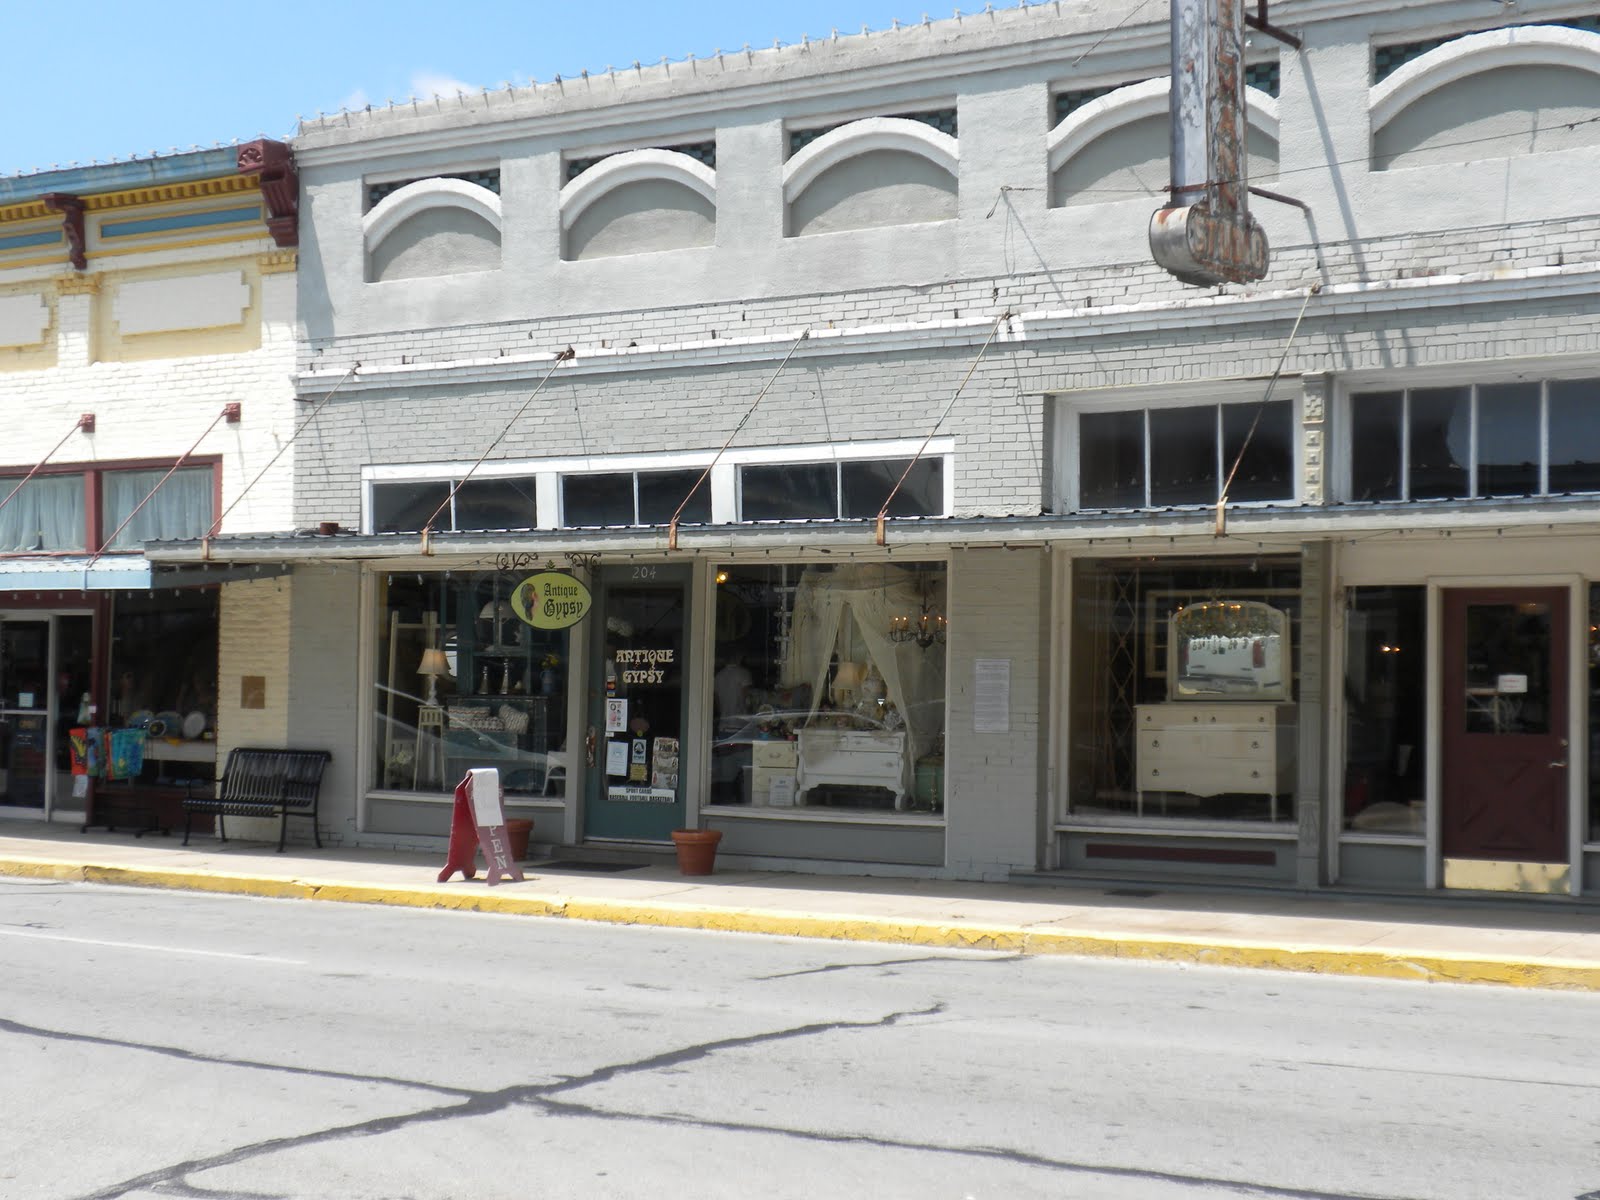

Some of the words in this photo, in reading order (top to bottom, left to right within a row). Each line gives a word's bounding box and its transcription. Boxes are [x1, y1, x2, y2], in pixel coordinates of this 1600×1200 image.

[632, 566, 656, 579] 204
[543, 582, 578, 598] Antique
[543, 599, 583, 620] Gypsy
[615, 649, 674, 667] ANTIQUE
[622, 670, 664, 684] GYPSY
[489, 825, 508, 870] PEN
